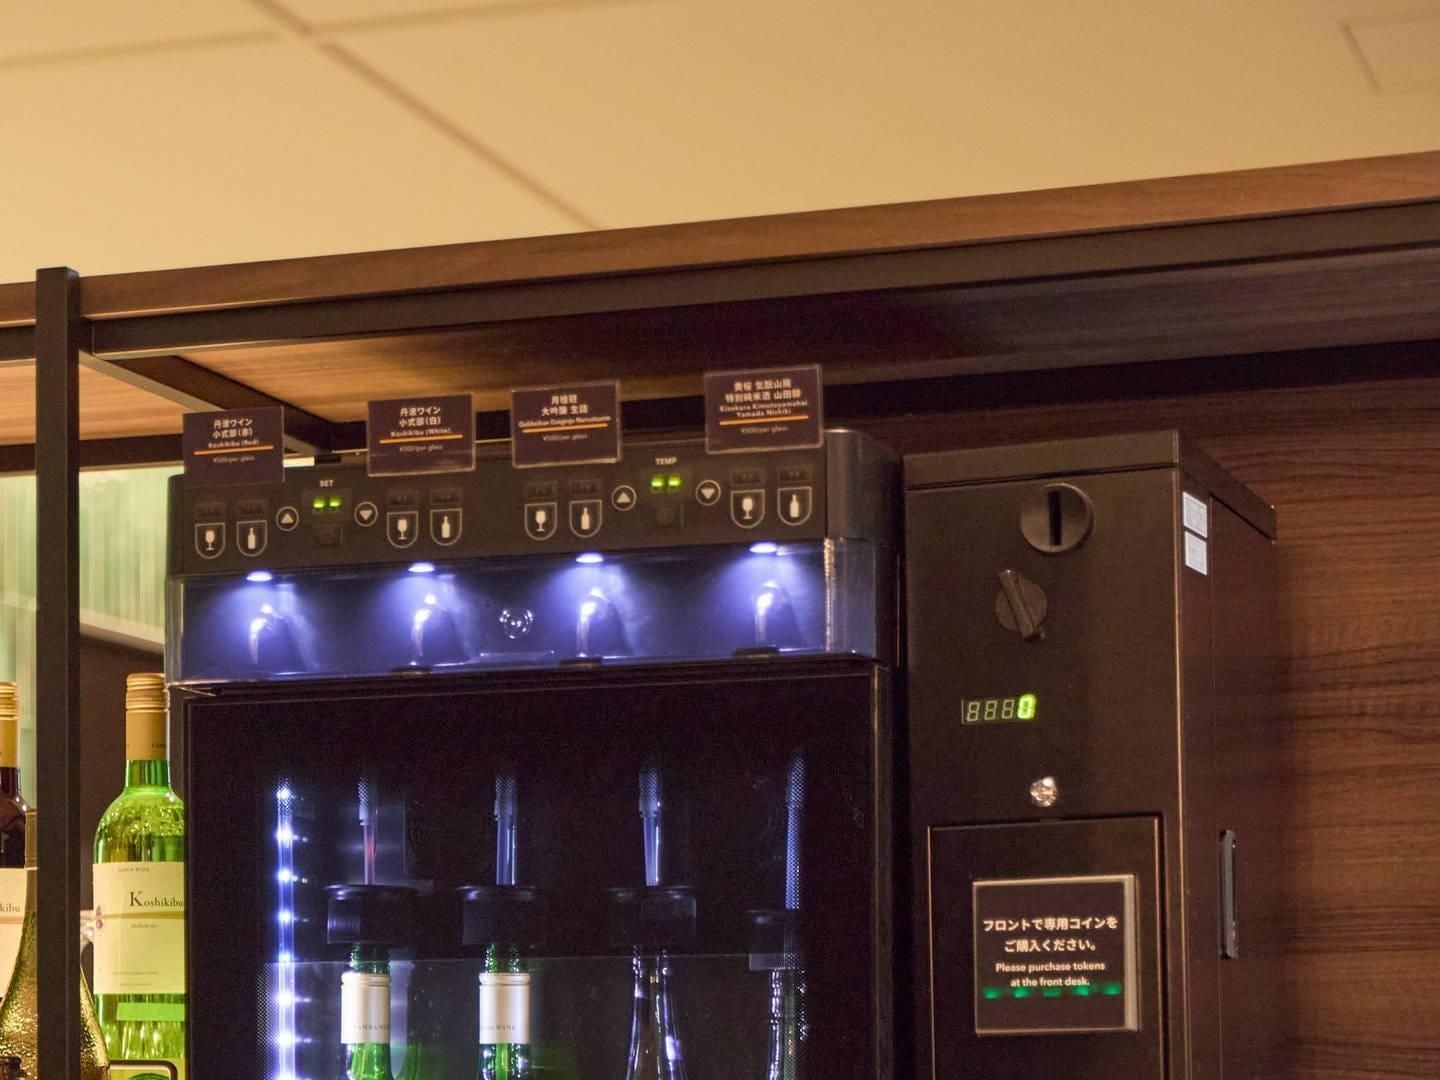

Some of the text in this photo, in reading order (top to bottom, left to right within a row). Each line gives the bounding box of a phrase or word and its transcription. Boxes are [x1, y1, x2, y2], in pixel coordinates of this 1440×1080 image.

[400, 406, 440, 416] 丹波ワイン
[214, 418, 253, 429] 丹波ワイン
[655, 456, 677, 465] TEMP
[320, 479, 334, 487] SET
[983, 916, 1119, 931] フロントで専用コインを
[1004, 939, 1096, 952] ご購入ください。
[995, 960, 1106, 974] Please purchase tokens
[1010, 976, 1090, 987] at the front desk.
